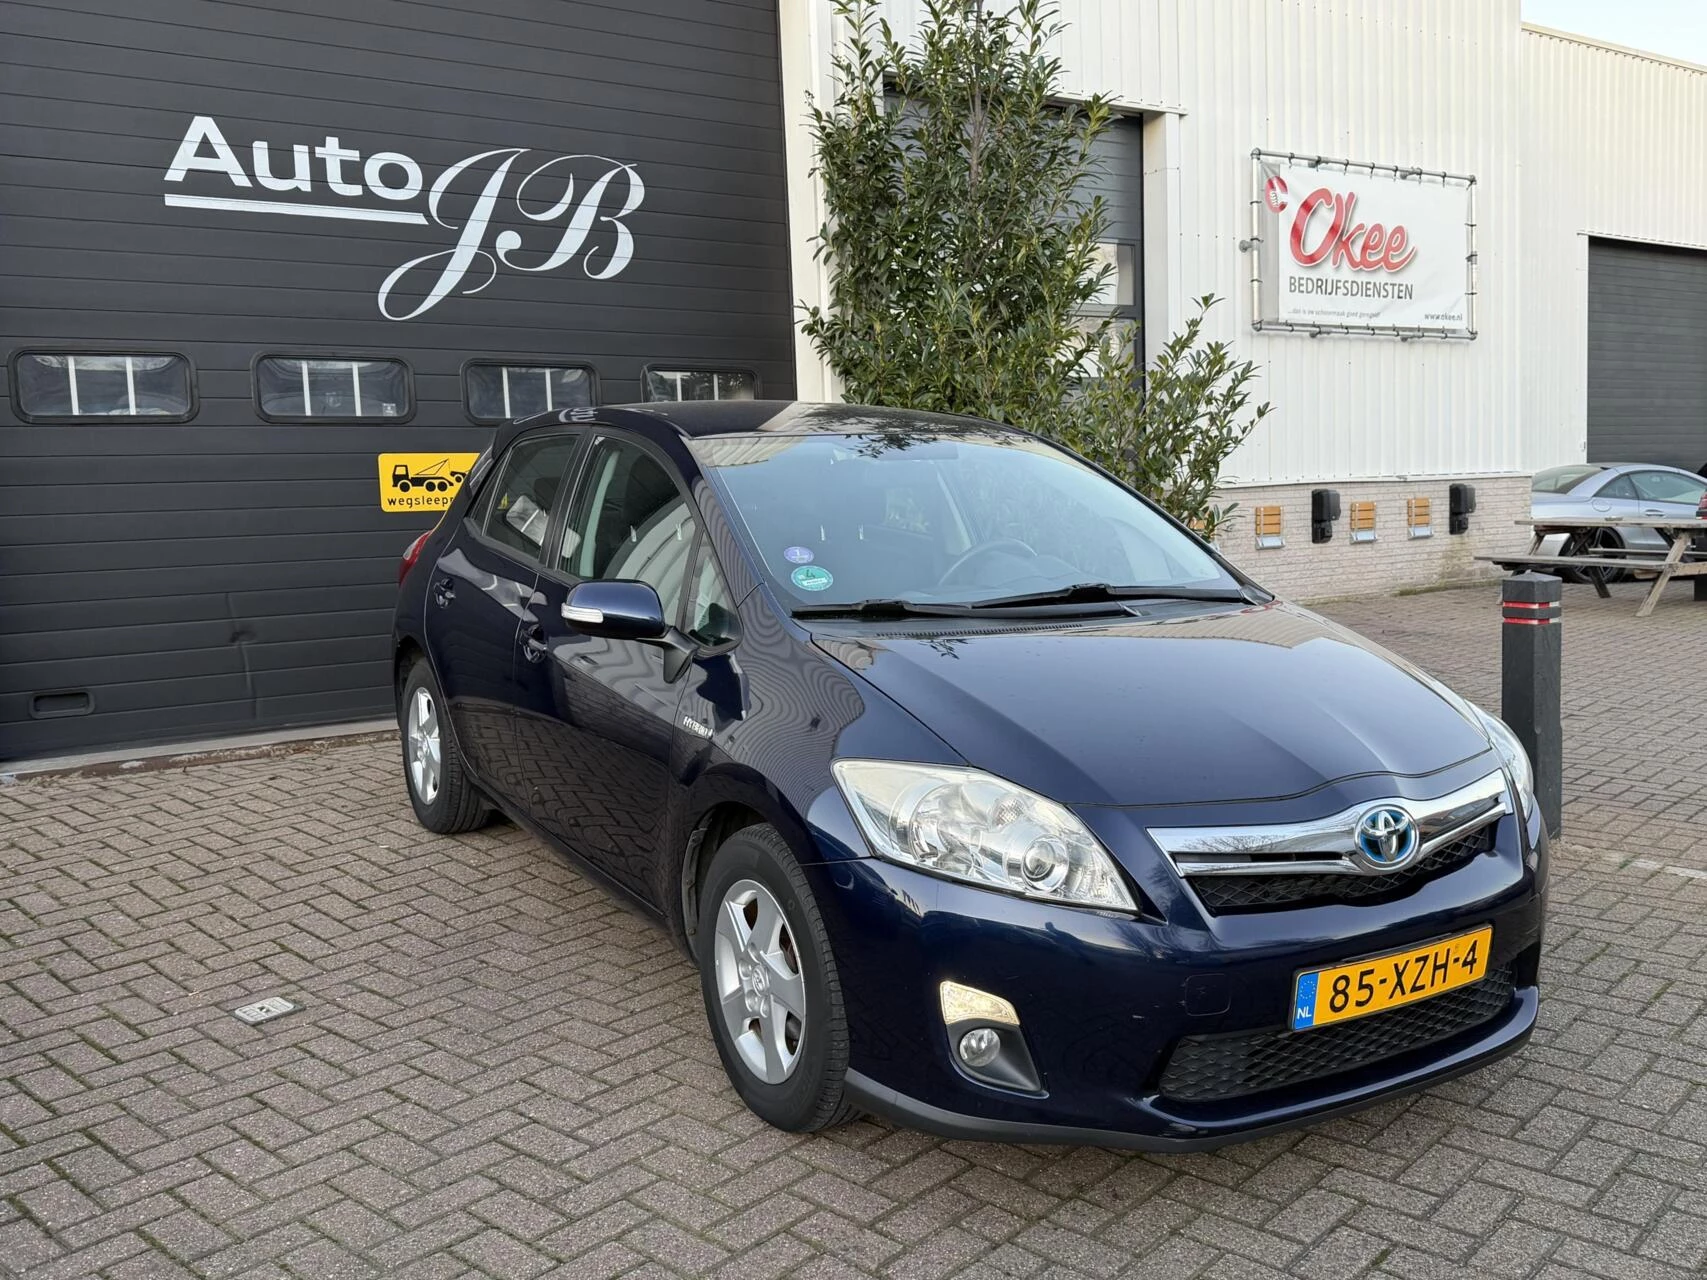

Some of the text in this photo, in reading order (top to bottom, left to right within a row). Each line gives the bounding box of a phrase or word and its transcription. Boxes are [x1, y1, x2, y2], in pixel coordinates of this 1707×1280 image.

[164, 115, 646, 322] Auto JB
[1290, 188, 1417, 272] Okee
[1289, 276, 1413, 299] BEDRIJFSDIENSTEN
[1296, 939, 1478, 1020] NL 85-XZH-4
